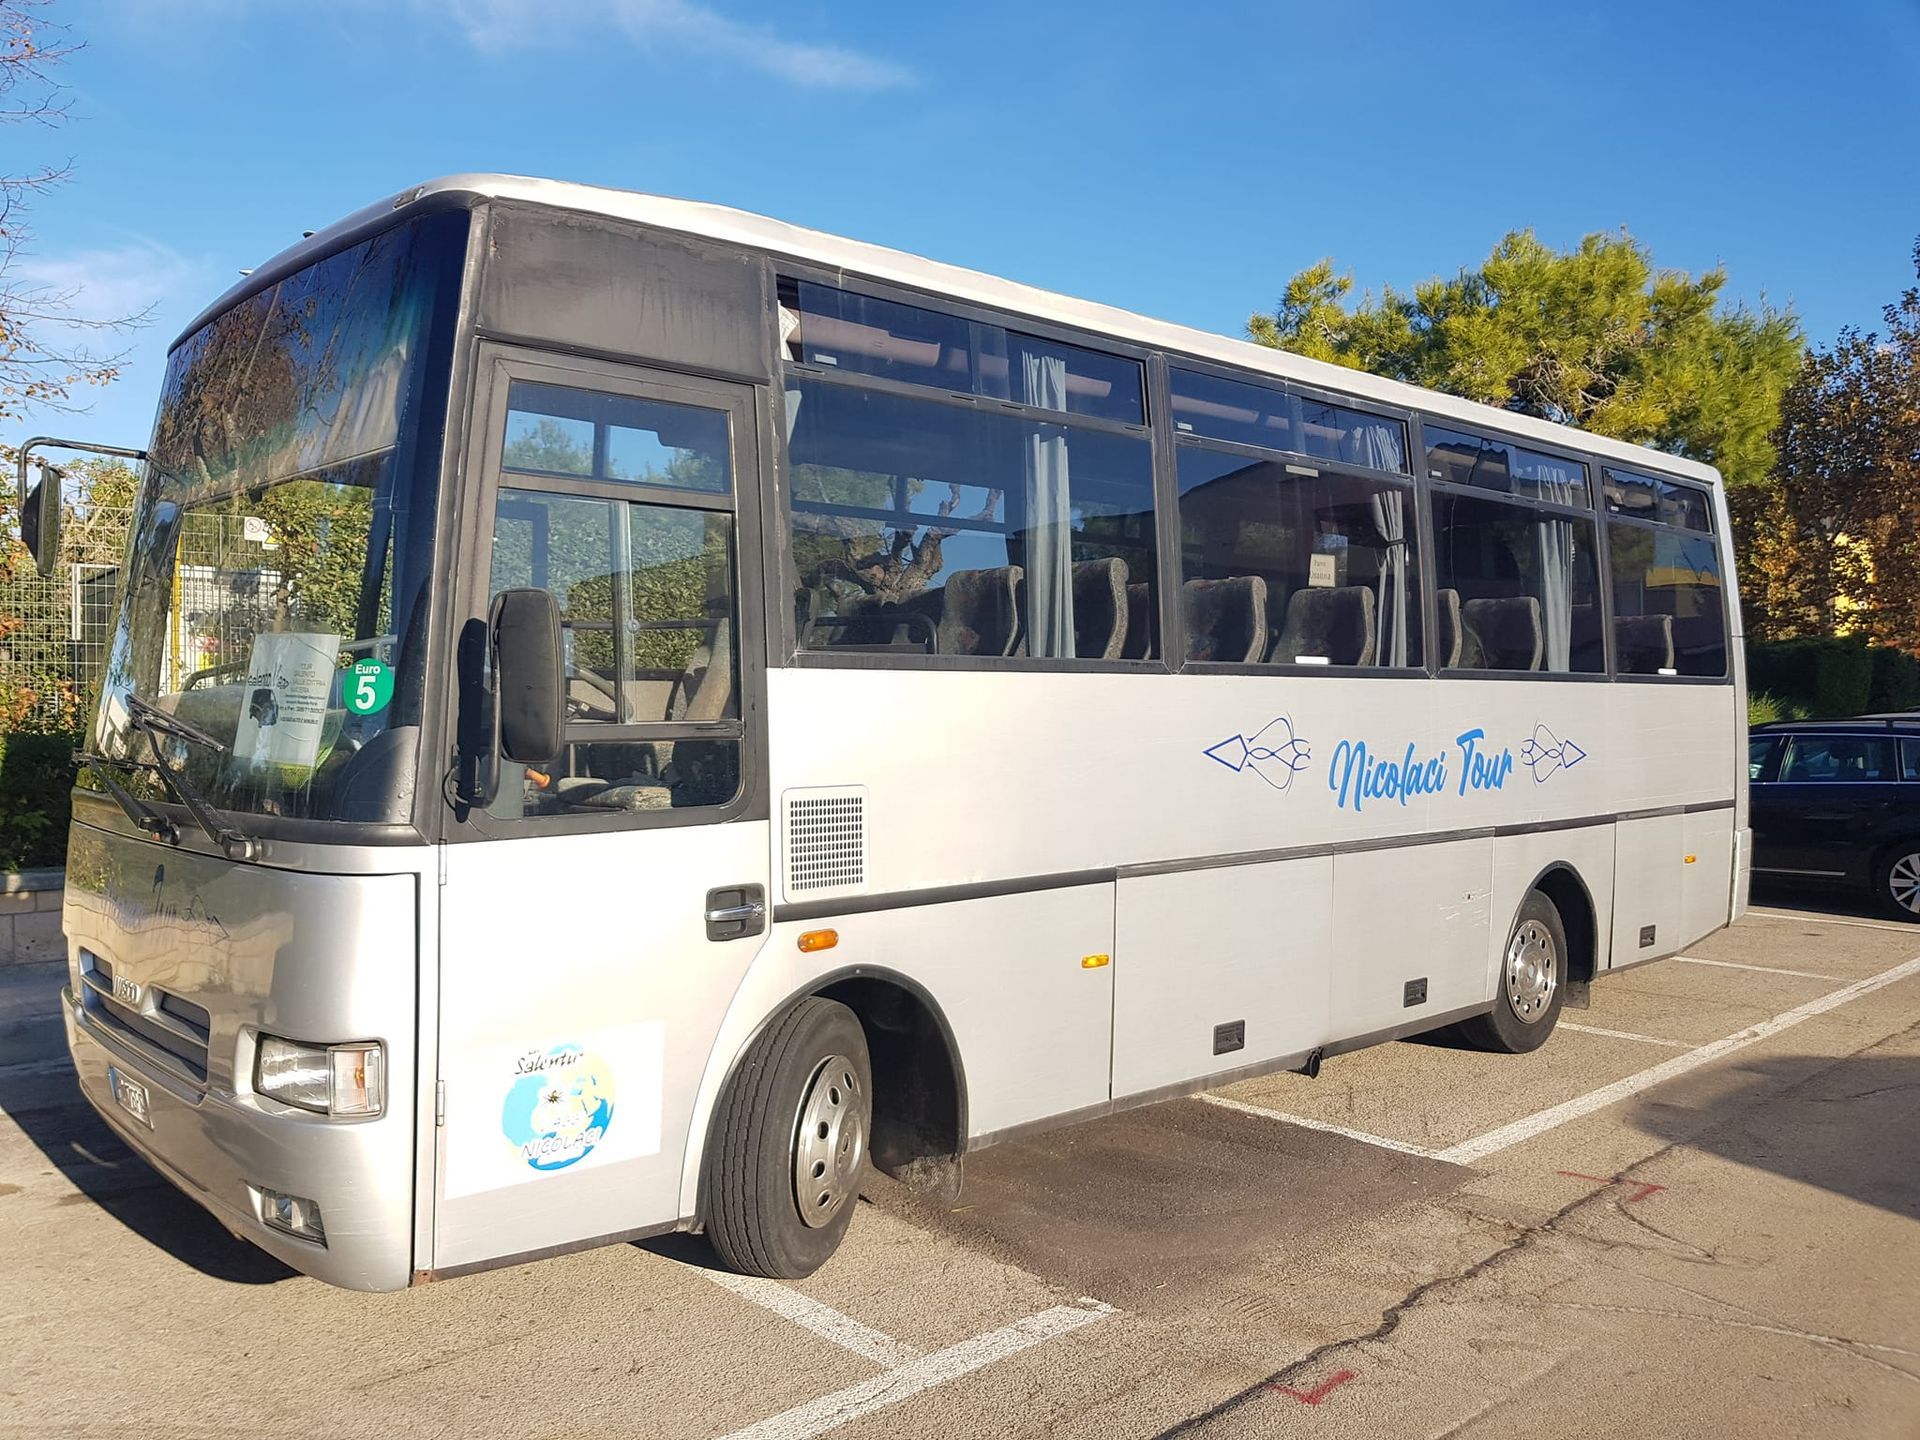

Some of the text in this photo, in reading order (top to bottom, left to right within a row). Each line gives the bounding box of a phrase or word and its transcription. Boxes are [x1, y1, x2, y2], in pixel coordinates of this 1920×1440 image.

[355, 664, 381, 674] Euro
[355, 675, 376, 710] 5
[1329, 728, 1513, 812] Nicolaci Tour
